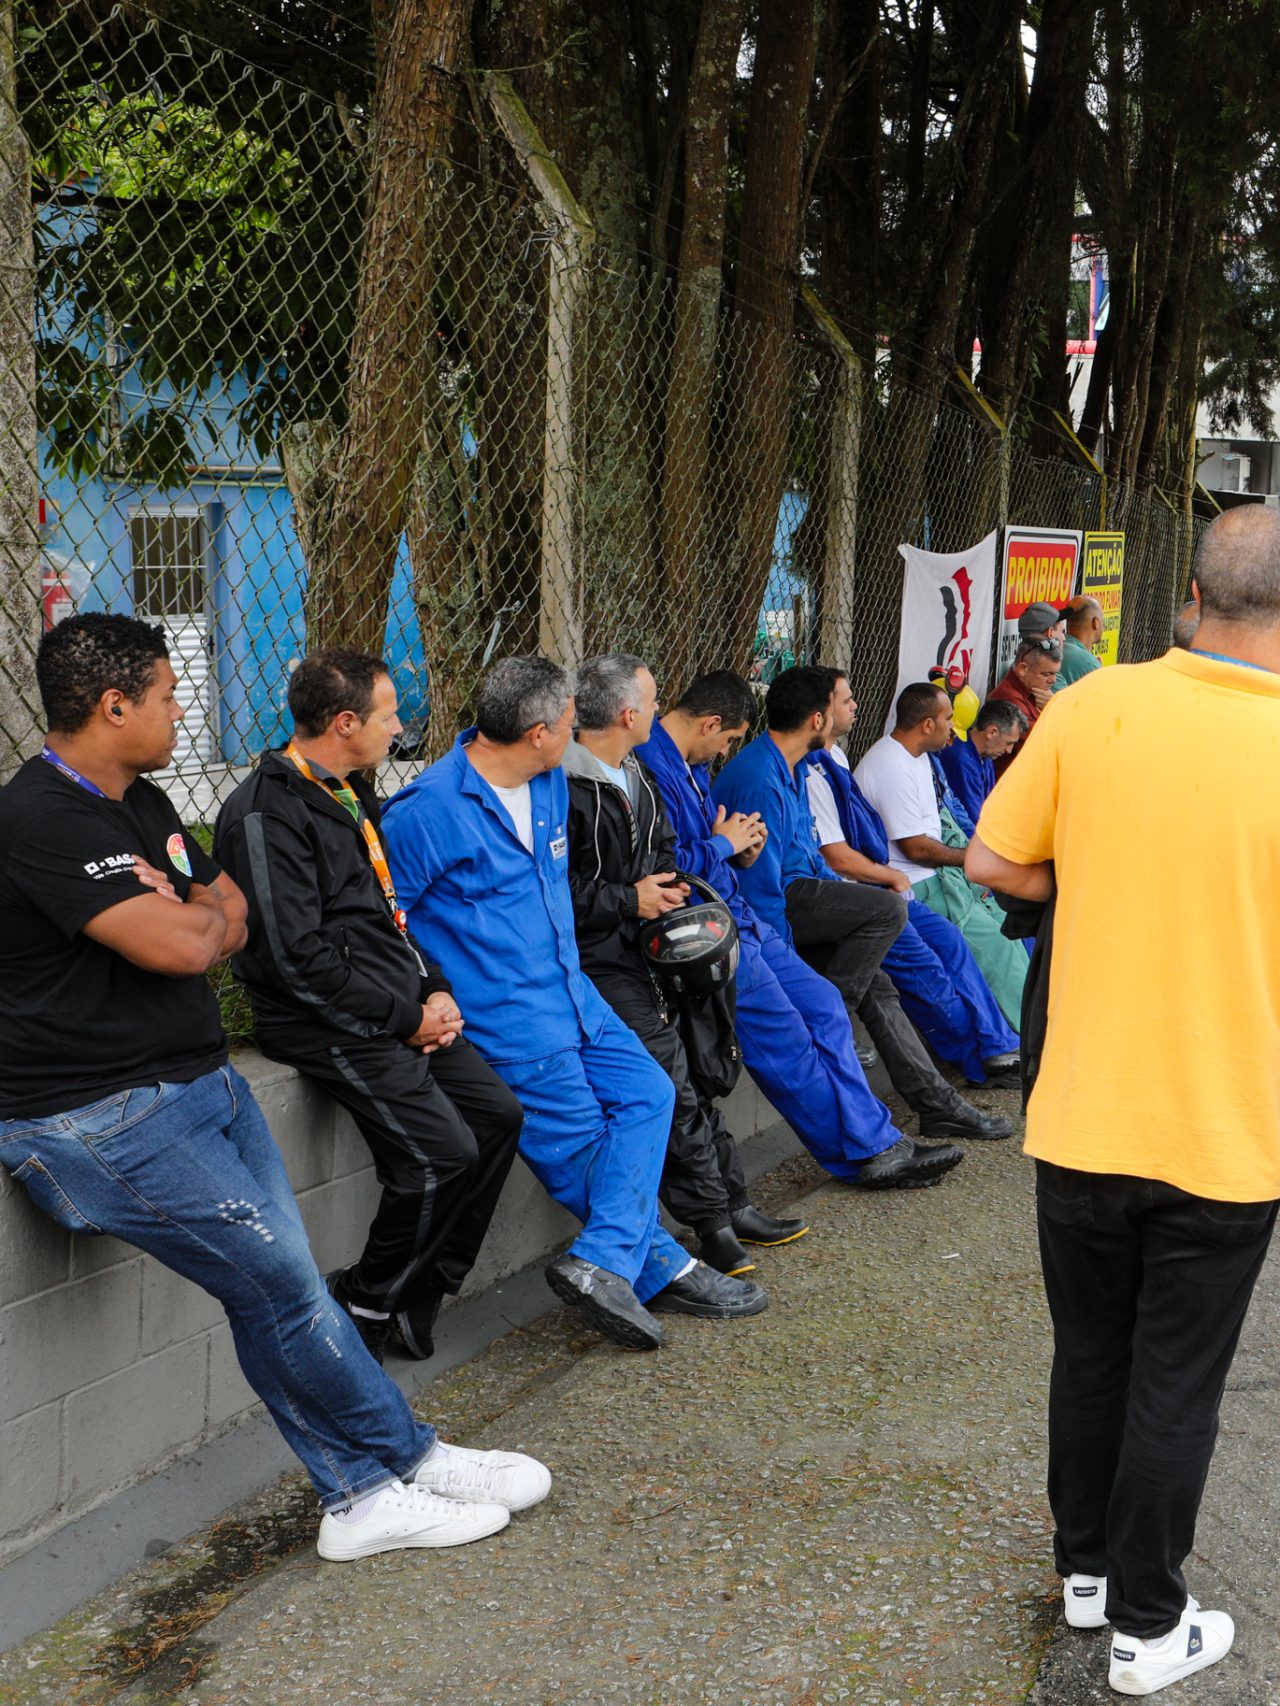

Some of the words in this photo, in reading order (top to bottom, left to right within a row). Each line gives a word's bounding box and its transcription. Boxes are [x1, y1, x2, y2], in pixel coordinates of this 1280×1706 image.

[1006, 556, 1072, 605] PROIBIDO
[1086, 542, 1122, 584] ATENÇÃO
[104, 853, 135, 868] BAS
